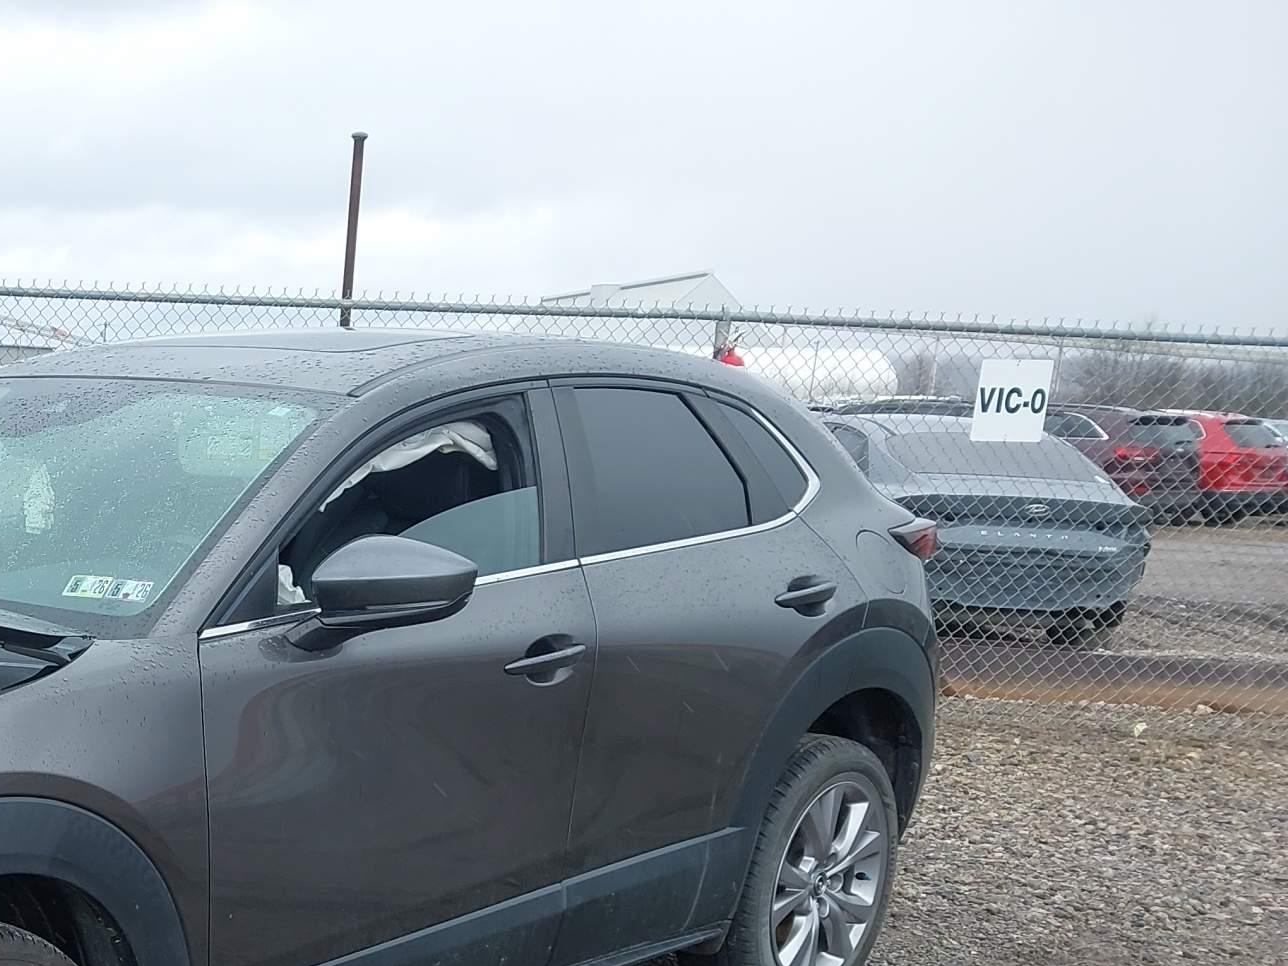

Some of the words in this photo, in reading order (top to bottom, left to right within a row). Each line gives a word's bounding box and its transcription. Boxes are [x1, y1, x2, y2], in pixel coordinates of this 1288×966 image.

[92, 579, 109, 595] 26
[112, 583, 123, 597] 5
[135, 583, 151, 599] 26
